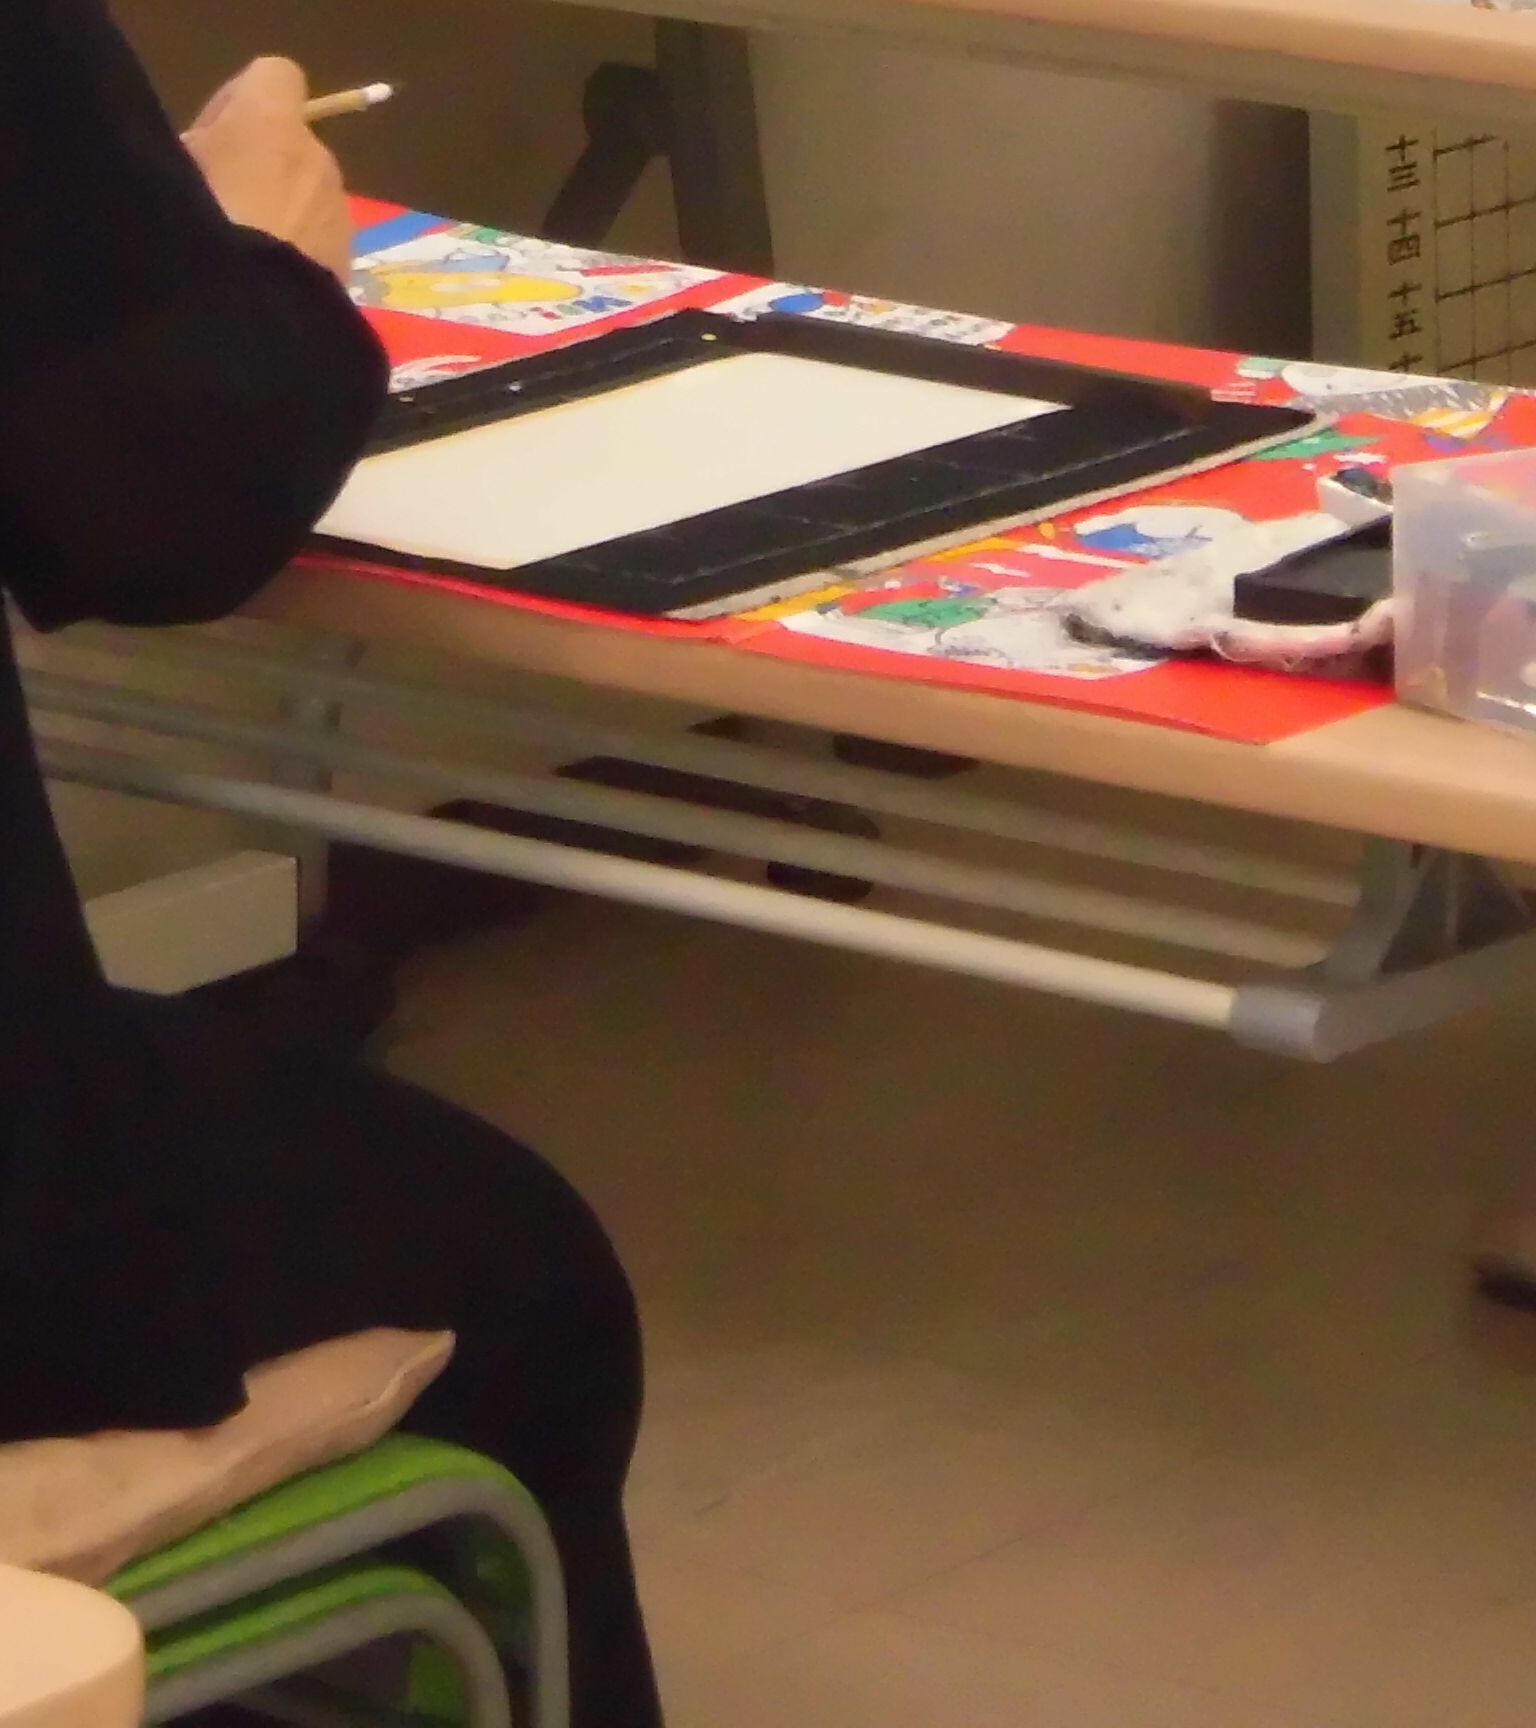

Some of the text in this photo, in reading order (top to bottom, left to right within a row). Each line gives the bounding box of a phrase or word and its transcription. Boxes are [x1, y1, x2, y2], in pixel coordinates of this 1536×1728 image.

[1385, 134, 1420, 192] 十三
[1386, 209, 1422, 265] 十四
[1388, 281, 1422, 340] 十五
